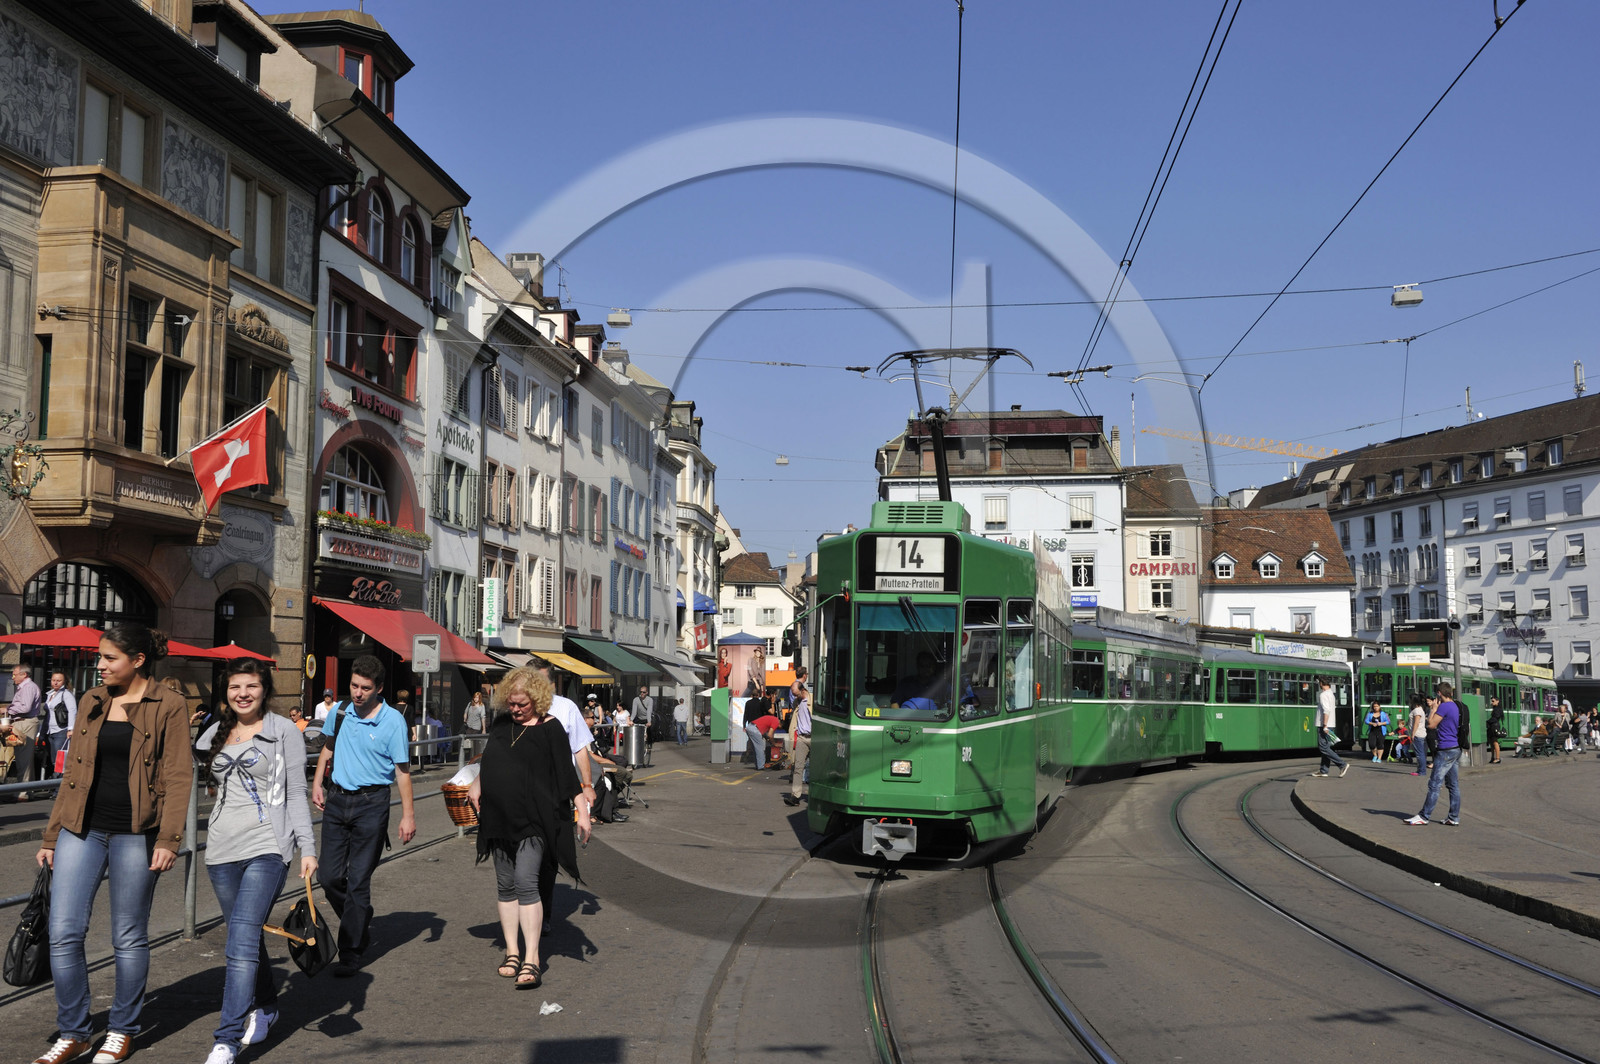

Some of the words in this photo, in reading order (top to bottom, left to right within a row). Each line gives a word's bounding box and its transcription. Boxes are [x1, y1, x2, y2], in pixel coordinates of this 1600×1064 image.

[373, 395, 404, 425] Fourny
[435, 418, 475, 455] Apotheke
[115, 480, 134, 499] ZUM
[897, 539, 925, 569] 14
[1129, 562, 1197, 576] CAMPARI
[348, 576, 376, 602] Rio
[375, 580, 403, 605] Bar
[880, 578, 940, 590] Muttenz-Pratteln
[485, 579, 496, 622] Apotheke
[1071, 595, 1089, 603] Allianz
[1374, 675, 1384, 685] 15
[961, 746, 972, 762] 502
